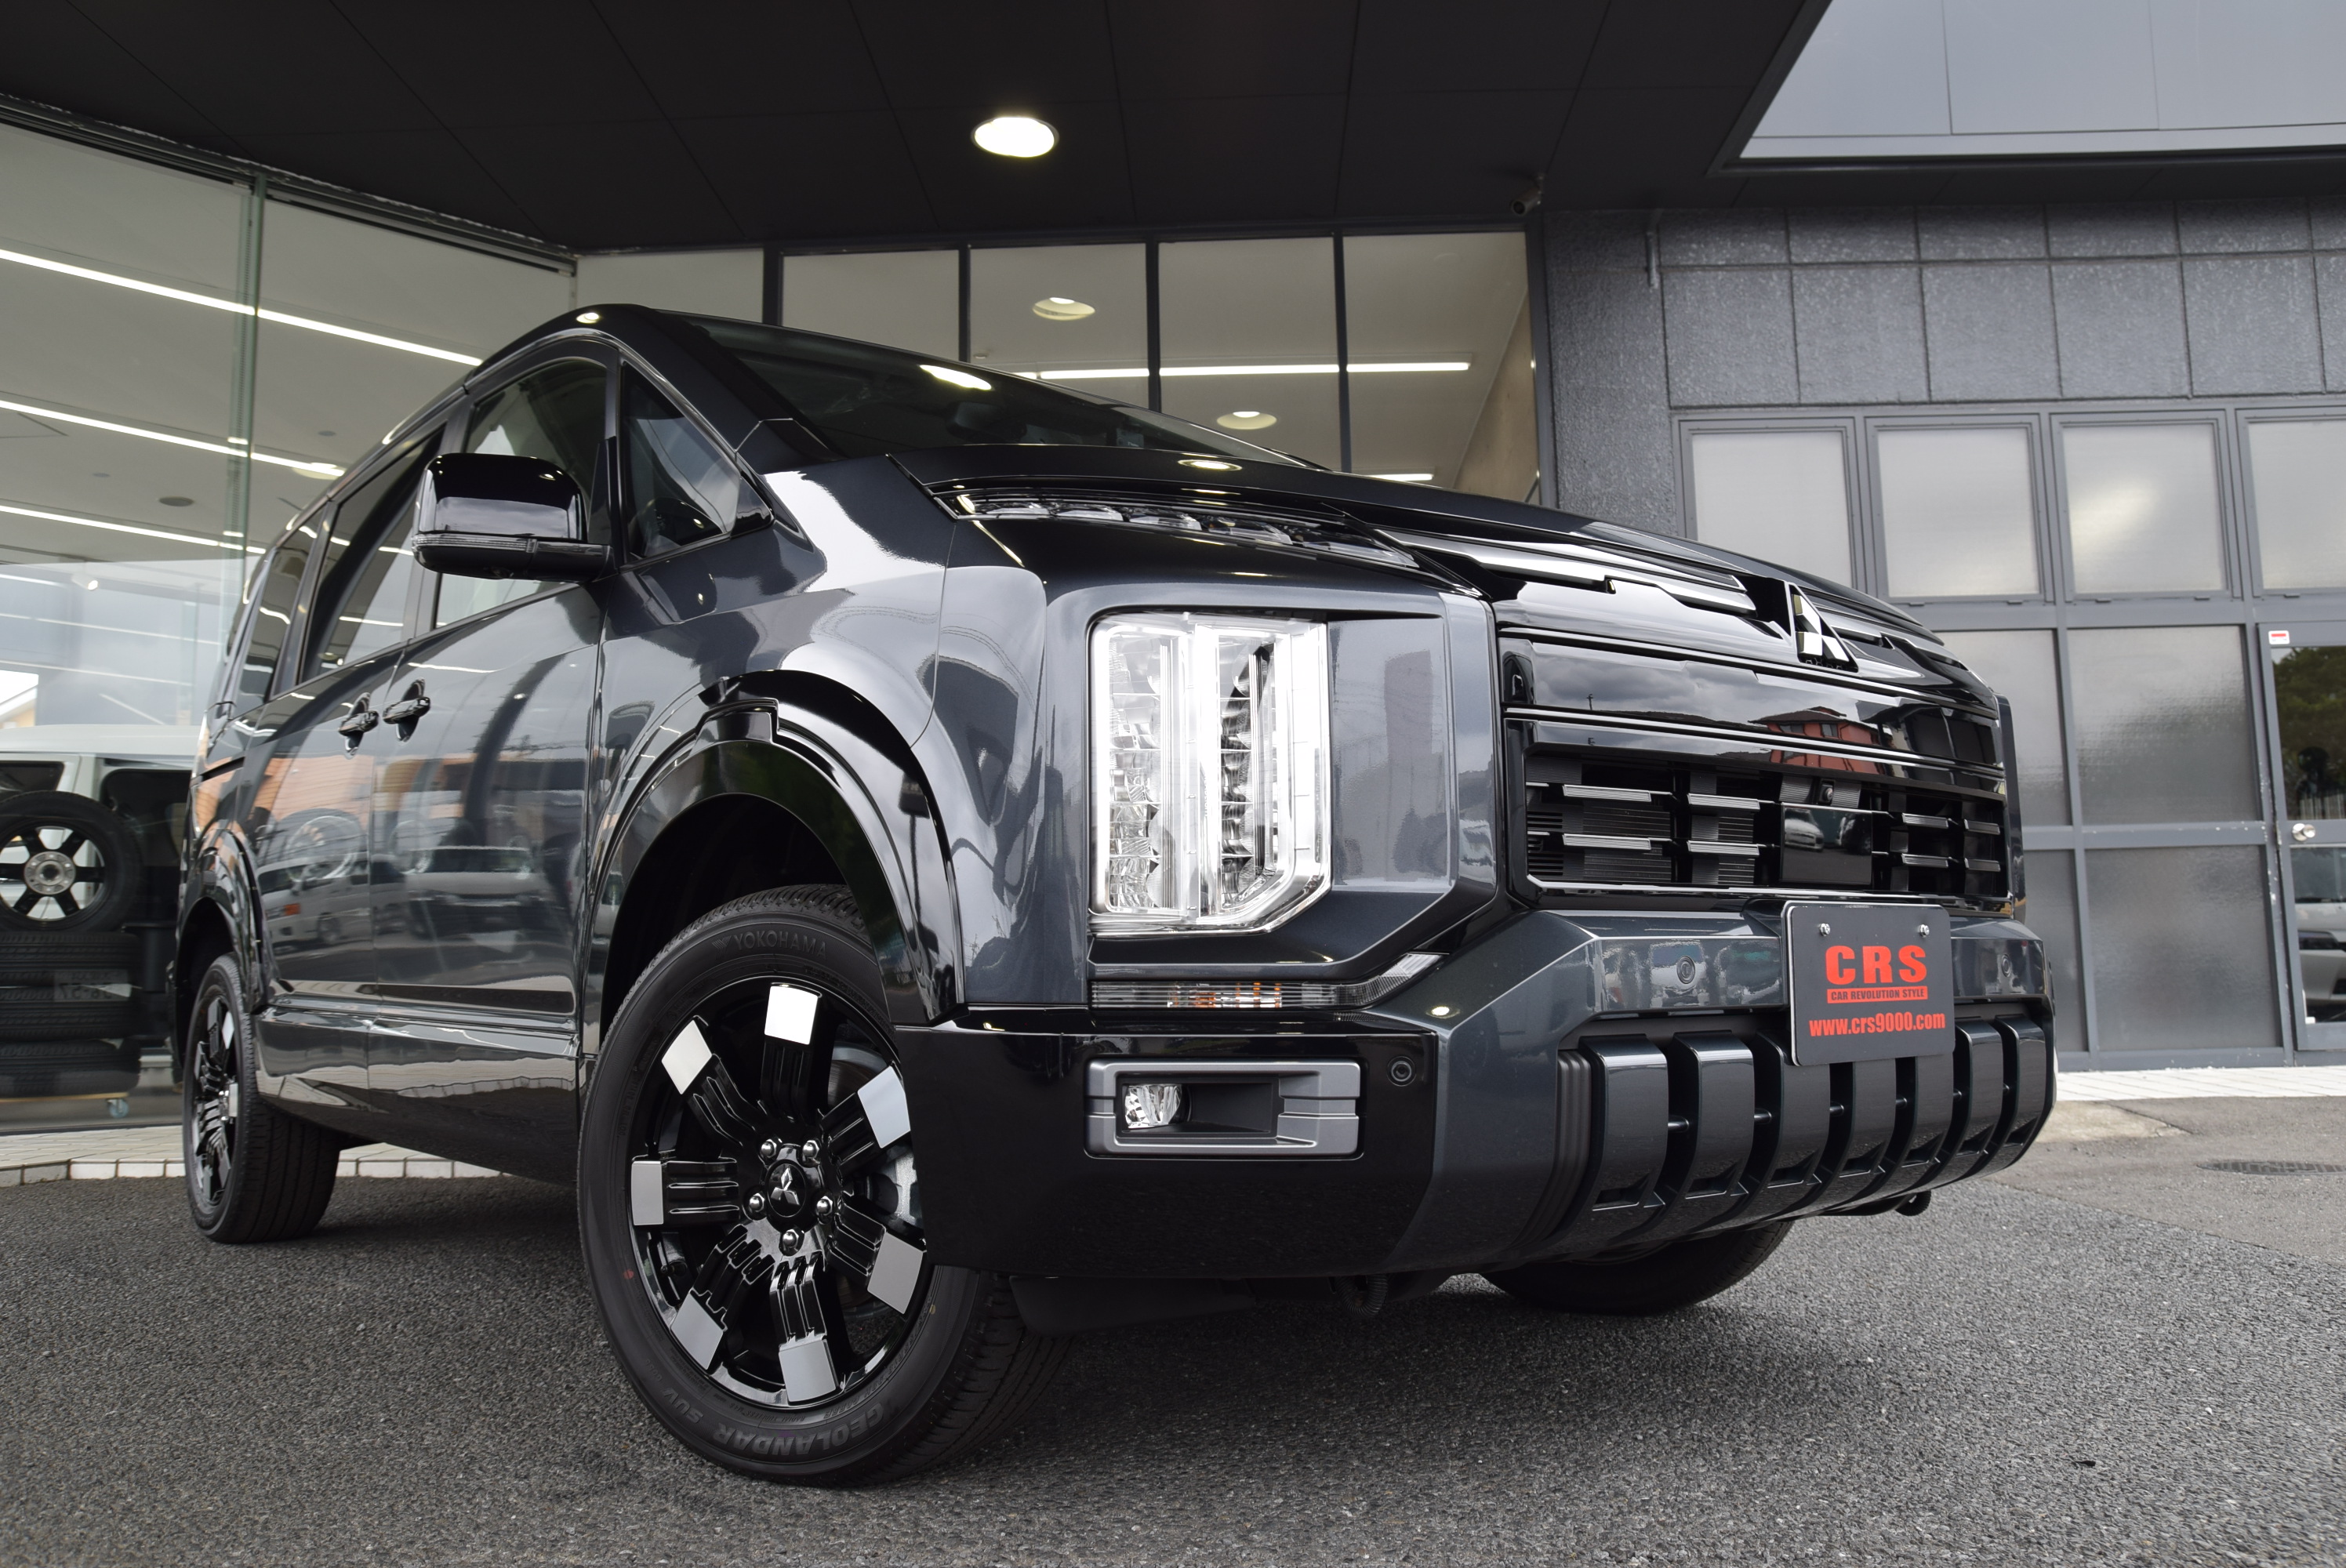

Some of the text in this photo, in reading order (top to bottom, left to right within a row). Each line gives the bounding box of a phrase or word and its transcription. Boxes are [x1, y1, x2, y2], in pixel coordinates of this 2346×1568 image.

[733, 929, 830, 960] YOKOHAMA
[1825, 945, 1927, 985] CRS
[1831, 988, 1925, 1000] CAR REVOLUTION STYLE
[1809, 1011, 1945, 1036] www.crs9000.com
[661, 1381, 703, 1427] SUV
[712, 1397, 888, 1457] GEOLANDAR
